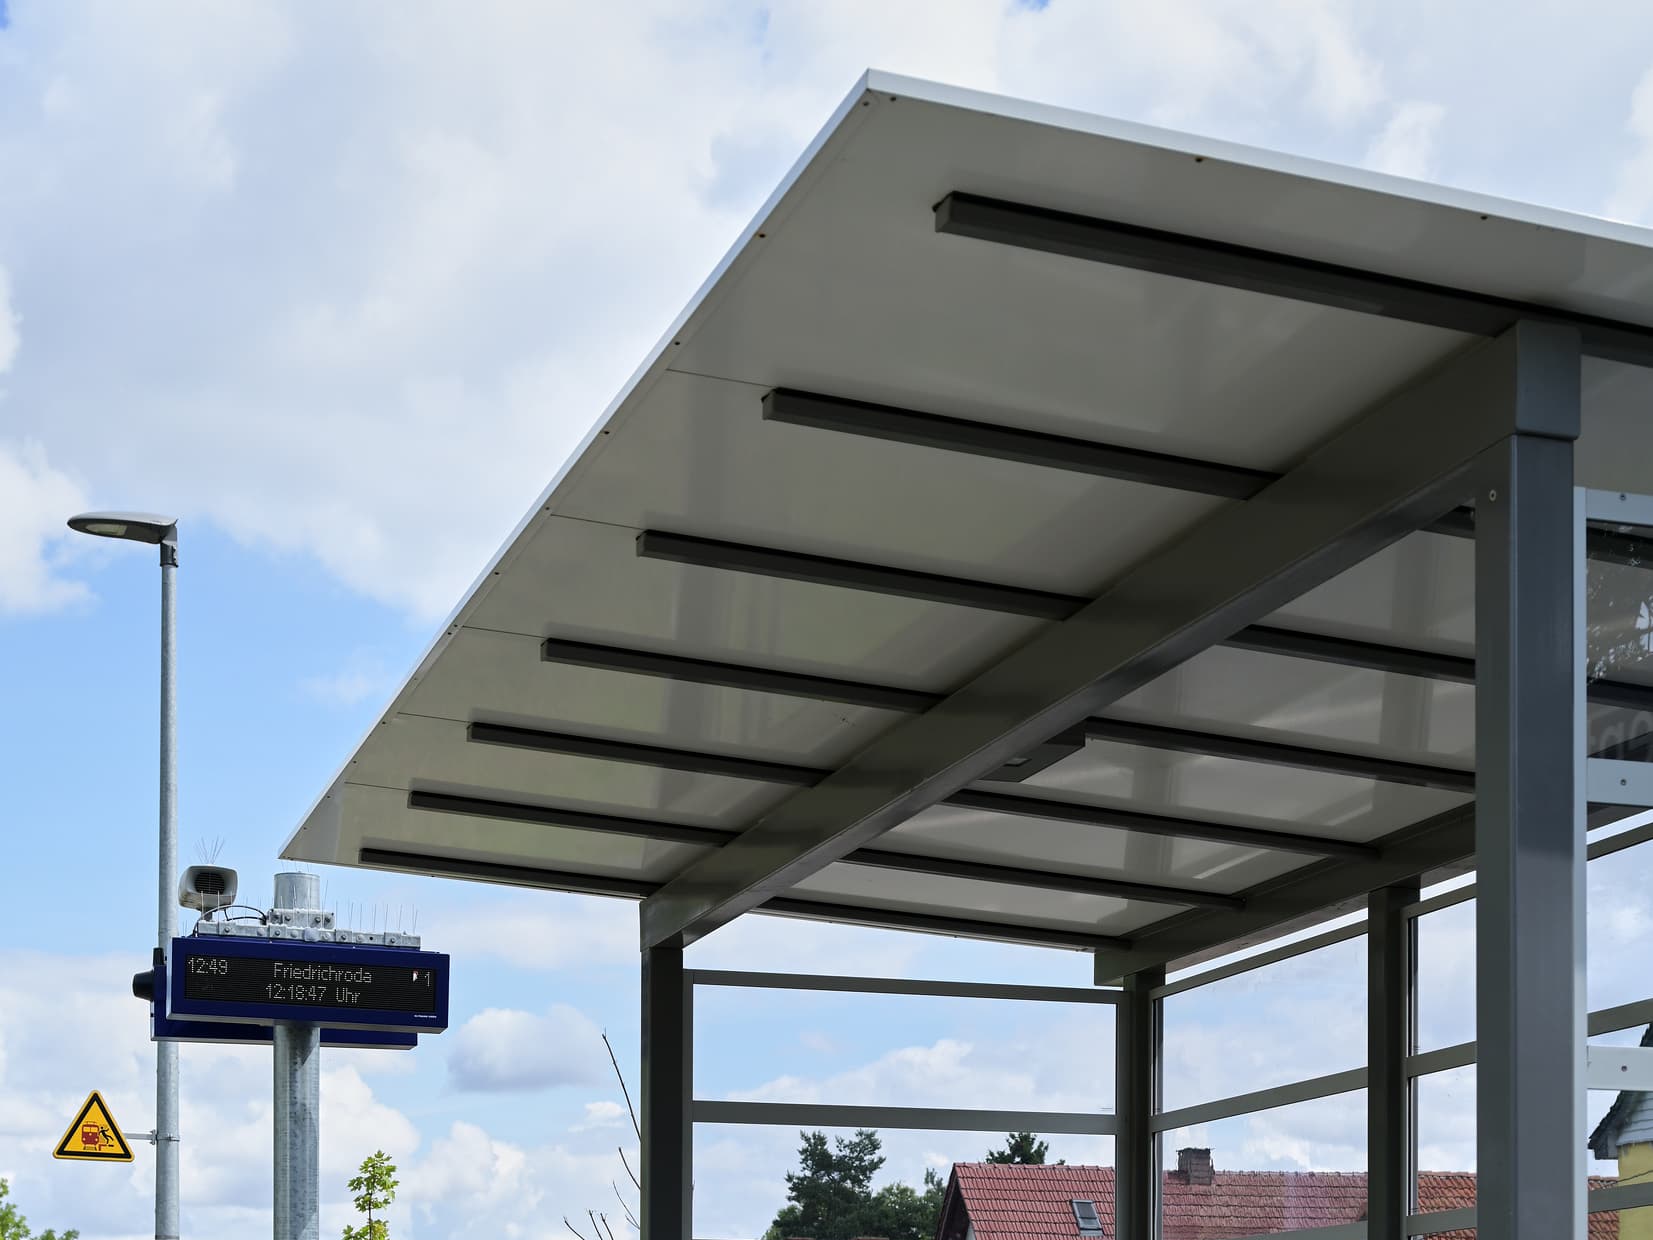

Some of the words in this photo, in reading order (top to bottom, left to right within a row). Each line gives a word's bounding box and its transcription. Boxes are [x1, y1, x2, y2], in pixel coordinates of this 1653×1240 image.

[187, 957, 228, 975] 12:49
[274, 962, 372, 983] Friedrichroda
[266, 983, 327, 1001] 12:18:47
[336, 987, 361, 1003] Uhr
